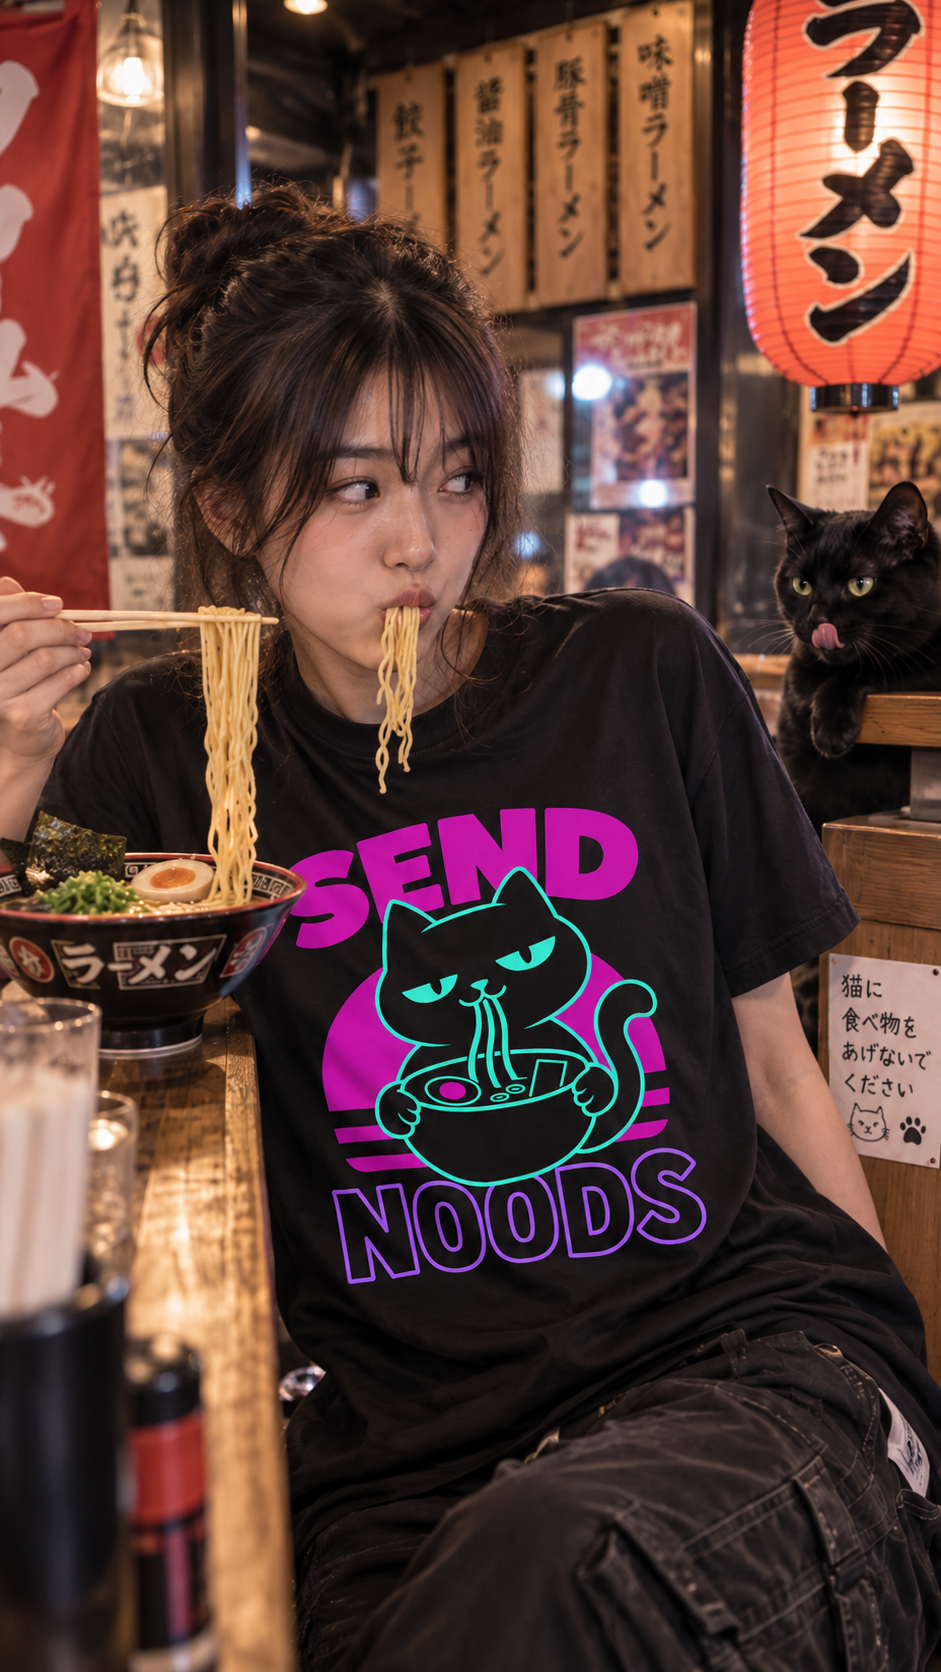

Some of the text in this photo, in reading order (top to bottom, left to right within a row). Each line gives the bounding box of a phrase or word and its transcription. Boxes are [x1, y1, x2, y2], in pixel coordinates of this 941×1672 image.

[474, 75, 506, 276] 醤油ラーメン
[554, 55, 586, 259] 豚骨ラーメン
[637, 34, 672, 252] 味噌ラーメン
[799, 0, 923, 345] ラーメン
[288, 808, 639, 949] SEND
[61, 943, 218, 985] ラーメン
[841, 974, 882, 998] 猫に
[842, 1007, 917, 1038] 食べ物を
[842, 1041, 932, 1070] あげないで
[844, 1073, 914, 1098] ください
[332, 1147, 707, 1284] NOODS
